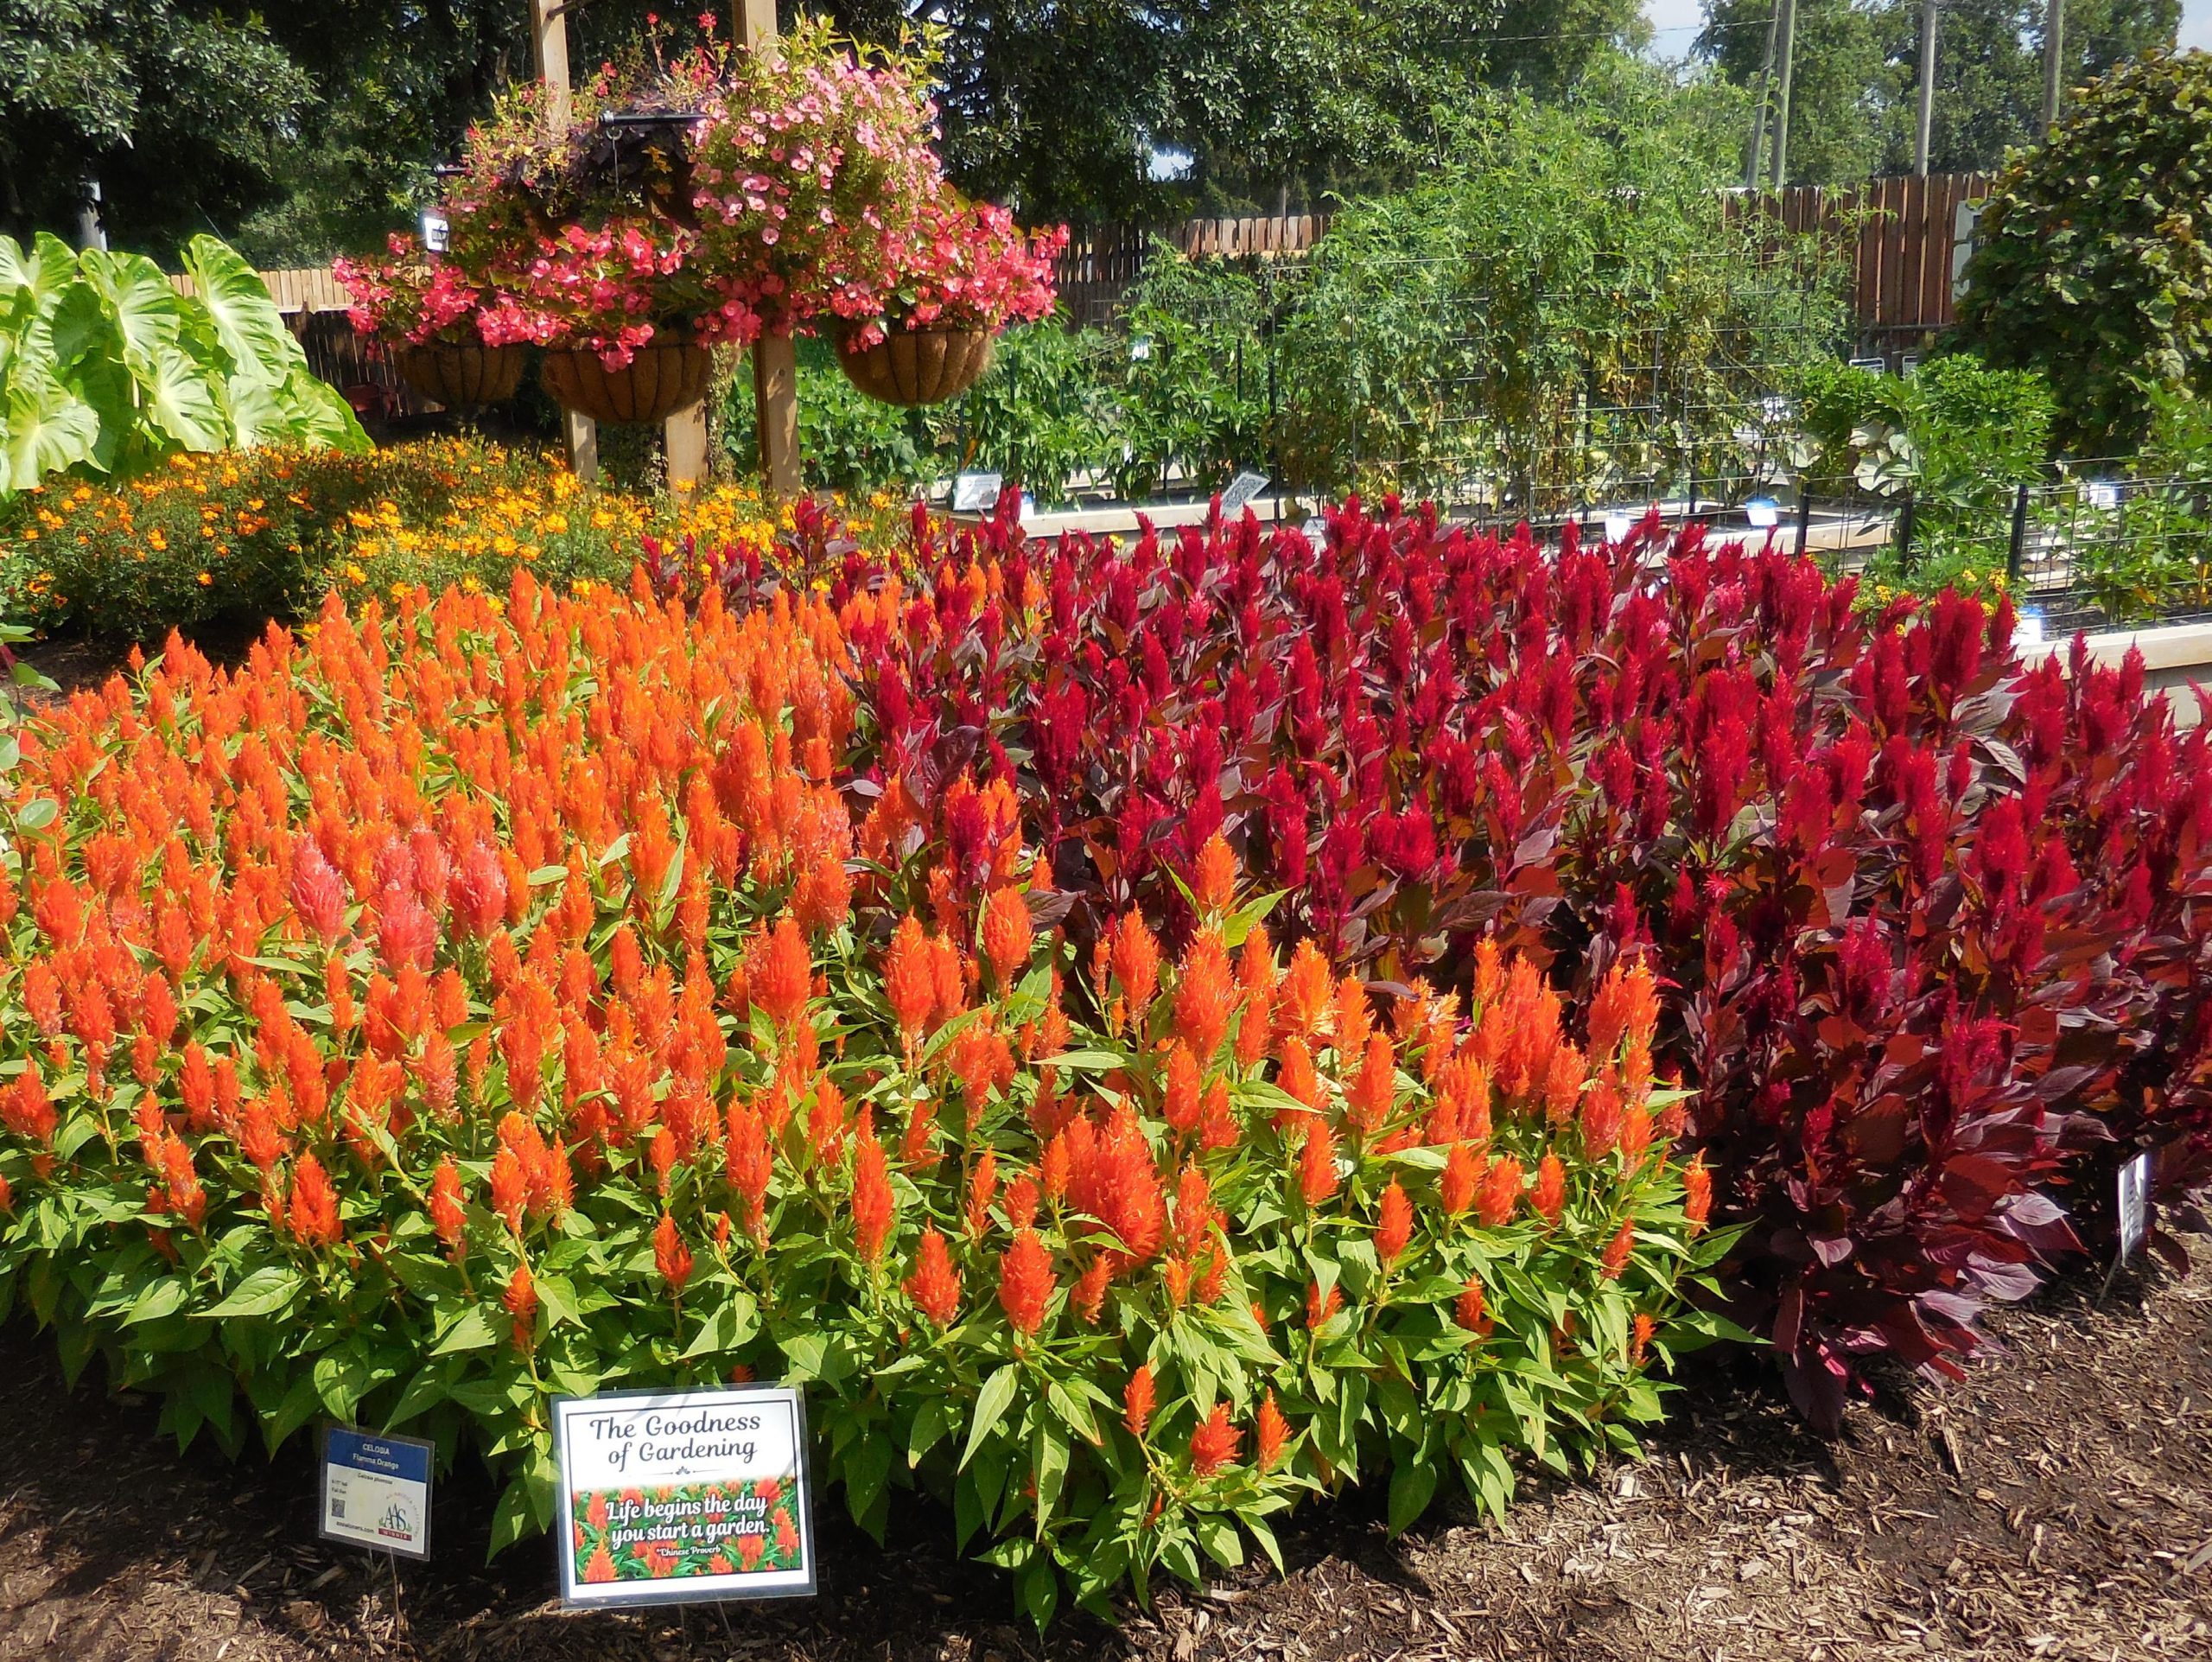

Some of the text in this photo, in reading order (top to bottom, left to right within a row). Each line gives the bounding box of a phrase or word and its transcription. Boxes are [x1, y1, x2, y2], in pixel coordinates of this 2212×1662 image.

[589, 1410, 761, 1441] The Goodness
[607, 1437, 758, 1473] of Gardening
[384, 1502, 406, 1532] AAS
[605, 1493, 768, 1526] Life begins the day
[612, 1516, 770, 1551] you start a garden.
[690, 1544, 721, 1555] Proverb
